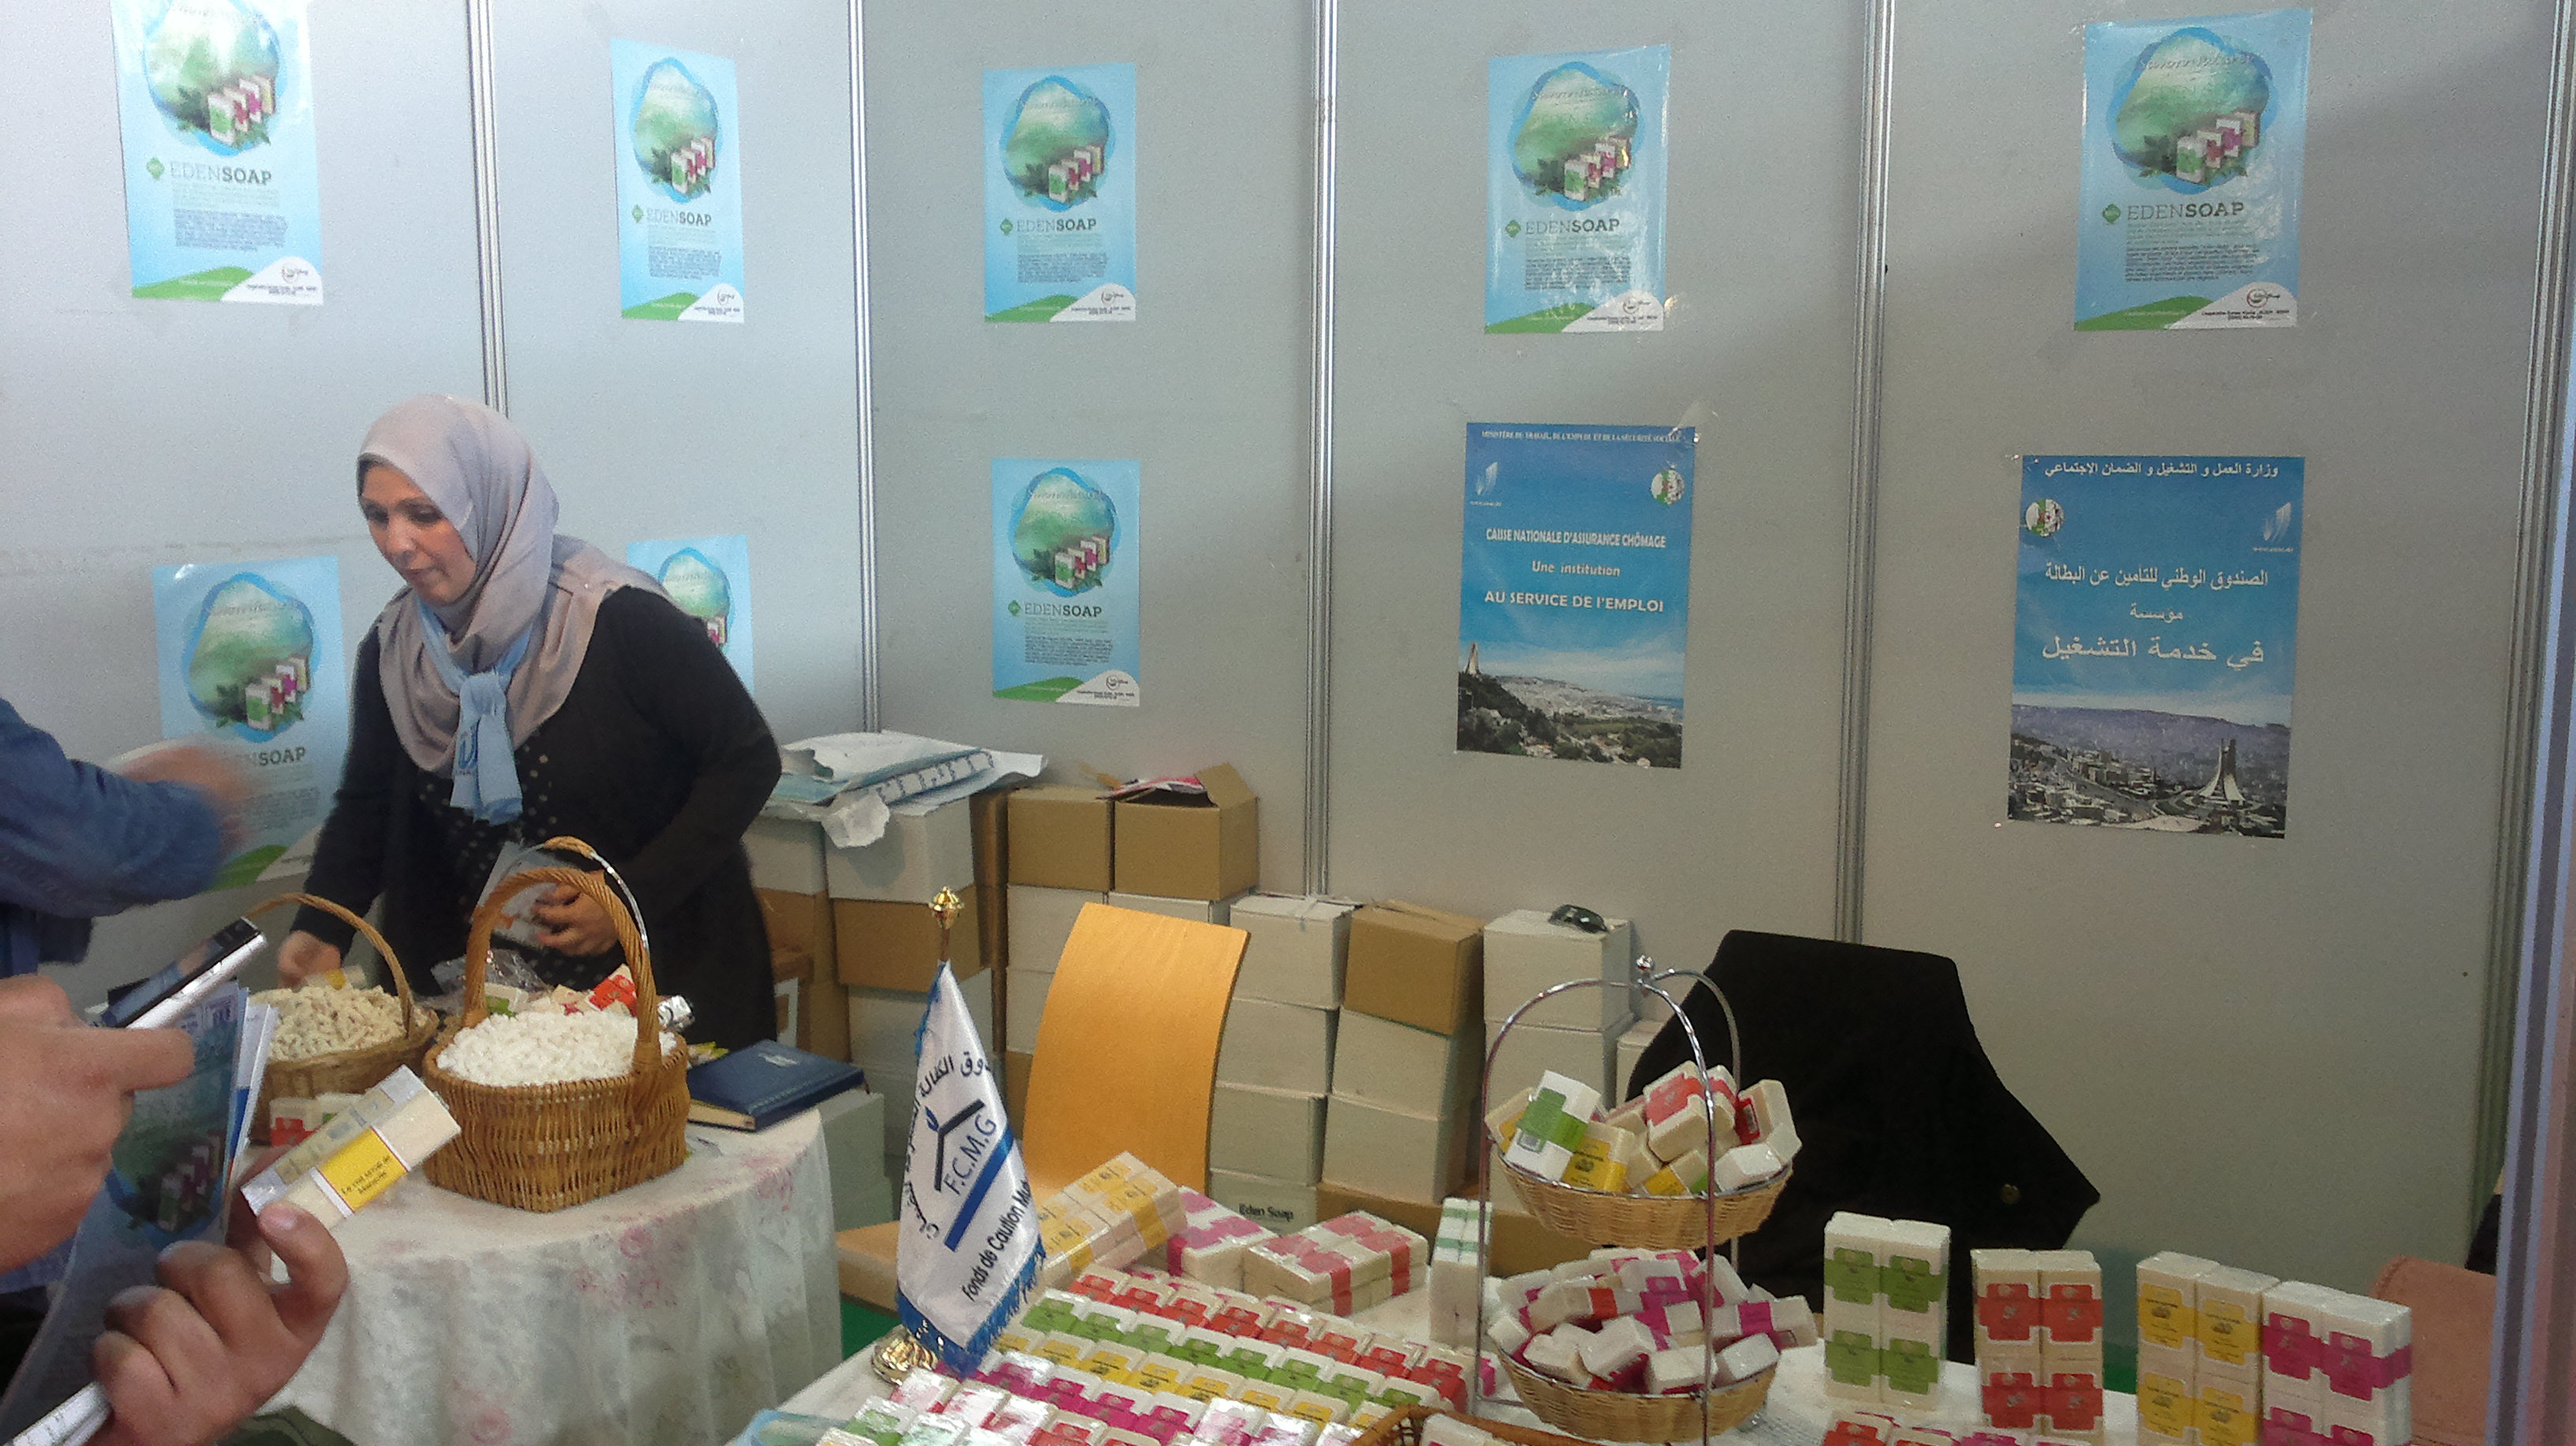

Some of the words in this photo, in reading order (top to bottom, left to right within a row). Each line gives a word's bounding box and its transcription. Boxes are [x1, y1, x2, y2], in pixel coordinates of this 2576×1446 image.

[170, 161, 272, 185] EDENSOAP
[646, 207, 713, 227] EDENSOAP
[2128, 202, 2245, 221] EDENSOAP
[1017, 218, 1097, 234] EDENSOAP
[1525, 218, 1620, 235] EDENSOAP
[2102, 463, 2142, 476] الضمان
[2156, 463, 2197, 477] التشغيل
[2212, 463, 2242, 477] العمل
[2245, 463, 2278, 478] وزارة
[1485, 528, 1513, 541] CAISSE
[1514, 529, 1562, 543] NATIONALE
[1563, 530, 1620, 546] D'ASSURANCE
[1622, 531, 1667, 549] CHÔMAGE
[1532, 560, 1556, 573] Une
[1560, 563, 1621, 577] institution
[2046, 562, 2085, 583] البطالة
[2090, 568, 2110, 586] عن
[2161, 567, 2206, 591] الوطني
[2210, 568, 2268, 591] الصندوق
[1484, 590, 1506, 603] AU
[1510, 592, 1568, 607] SERVICE
[1572, 595, 1593, 609] DE
[1024, 602, 1103, 618] EDENSOAP
[2129, 602, 2184, 624] مؤسسة
[2042, 635, 2137, 660] التشغيل
[2147, 635, 2217, 661] خدمة
[2226, 640, 2264, 671] في
[1238, 1203, 1266, 1216] Eden
[1267, 1206, 1294, 1223] Soap
[987, 1204, 1024, 1252] Caution
[979, 1249, 998, 1269] de
[961, 1265, 989, 1302] Fonds
